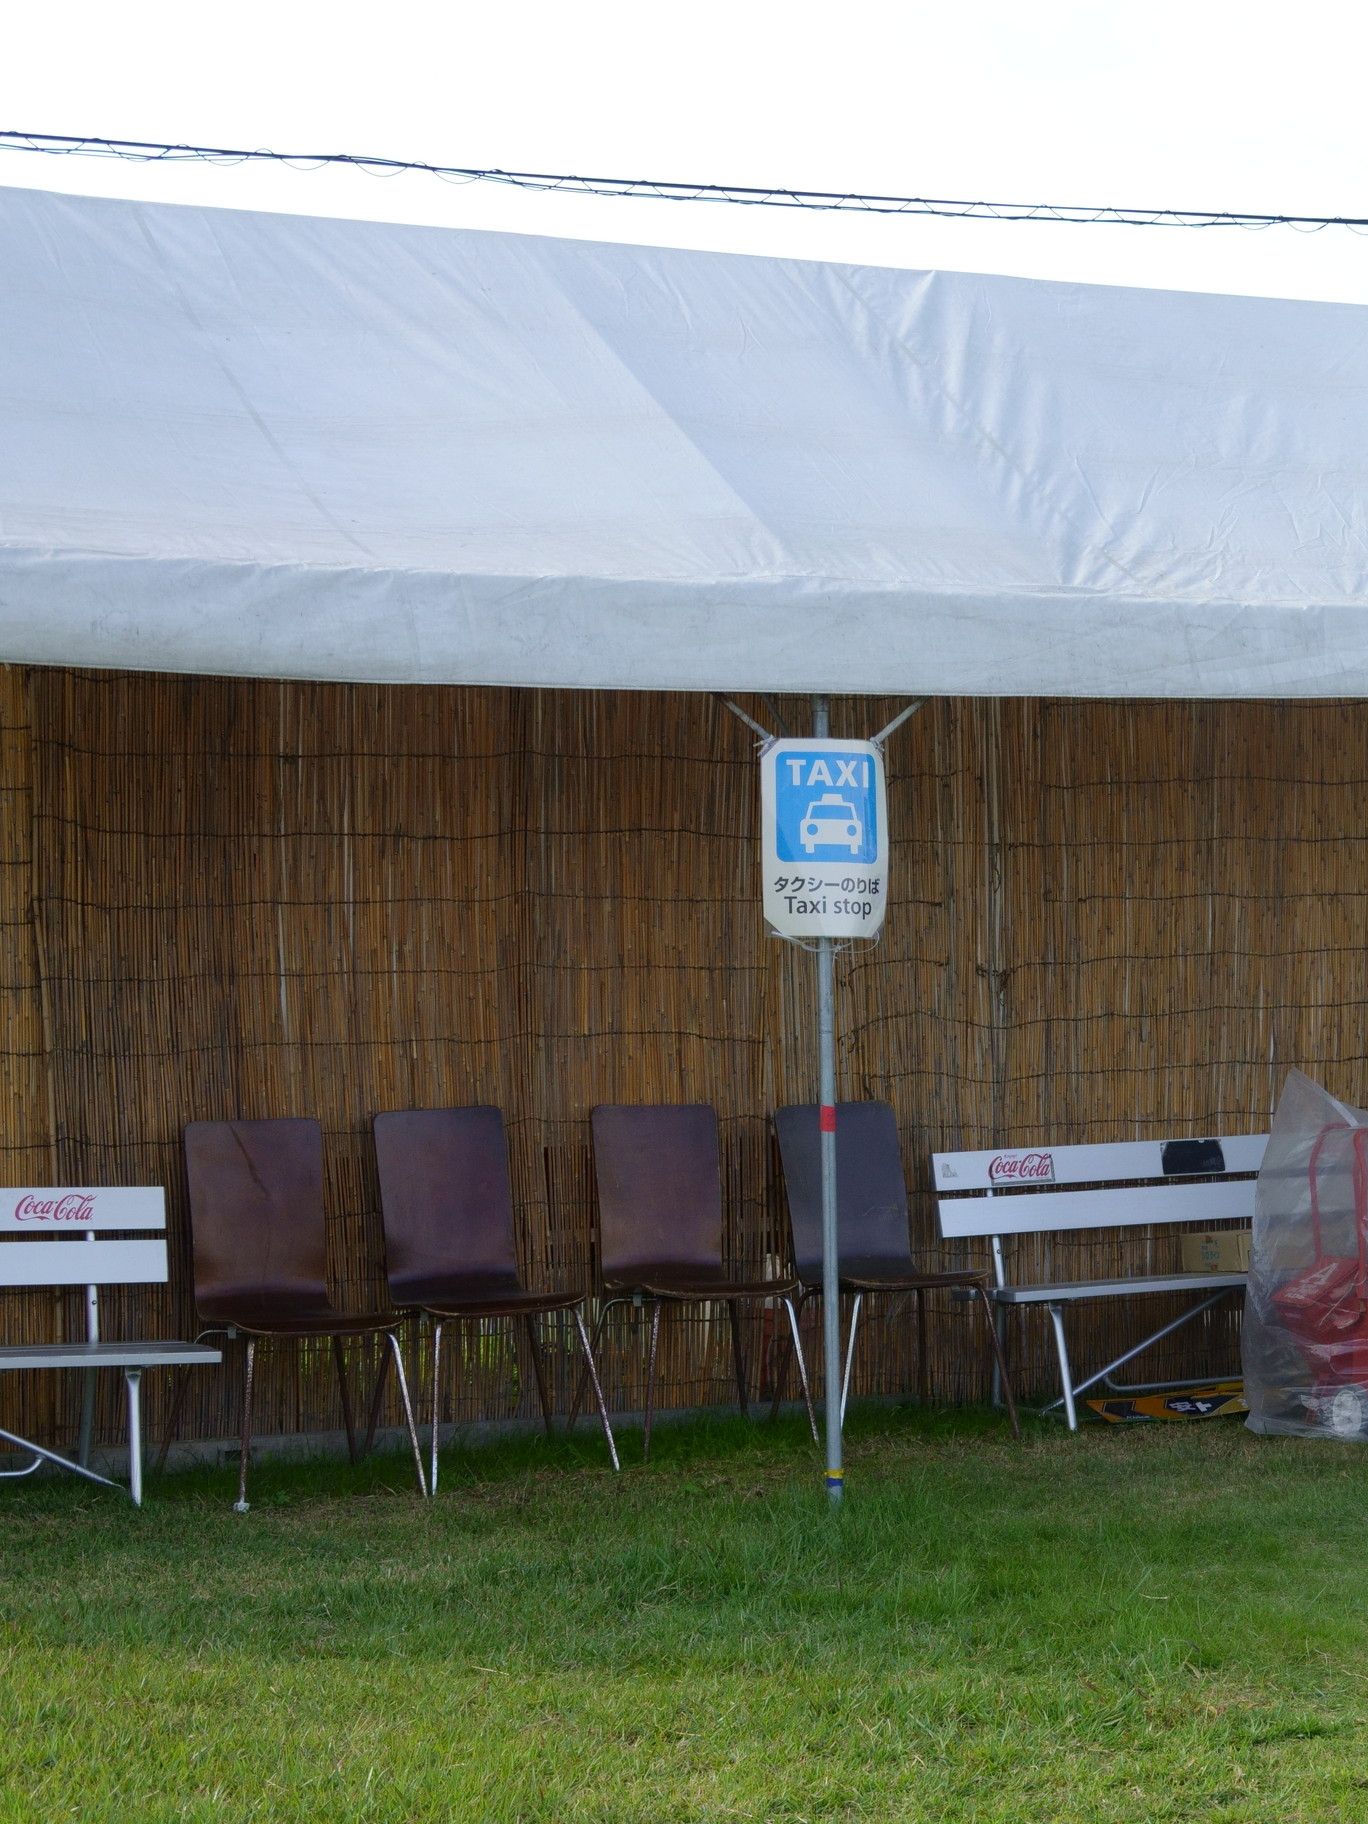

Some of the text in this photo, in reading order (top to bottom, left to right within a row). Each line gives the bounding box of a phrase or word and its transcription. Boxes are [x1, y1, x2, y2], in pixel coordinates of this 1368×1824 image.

[786, 759, 869, 788] TAXI
[773, 876, 881, 894] タクシーのりば
[784, 896, 872, 920] Taxi stop
[988, 1153, 1053, 1179] Coca-Cola
[14, 1194, 98, 1221] Coca-Cola
[1298, 1262, 1340, 1286] A
